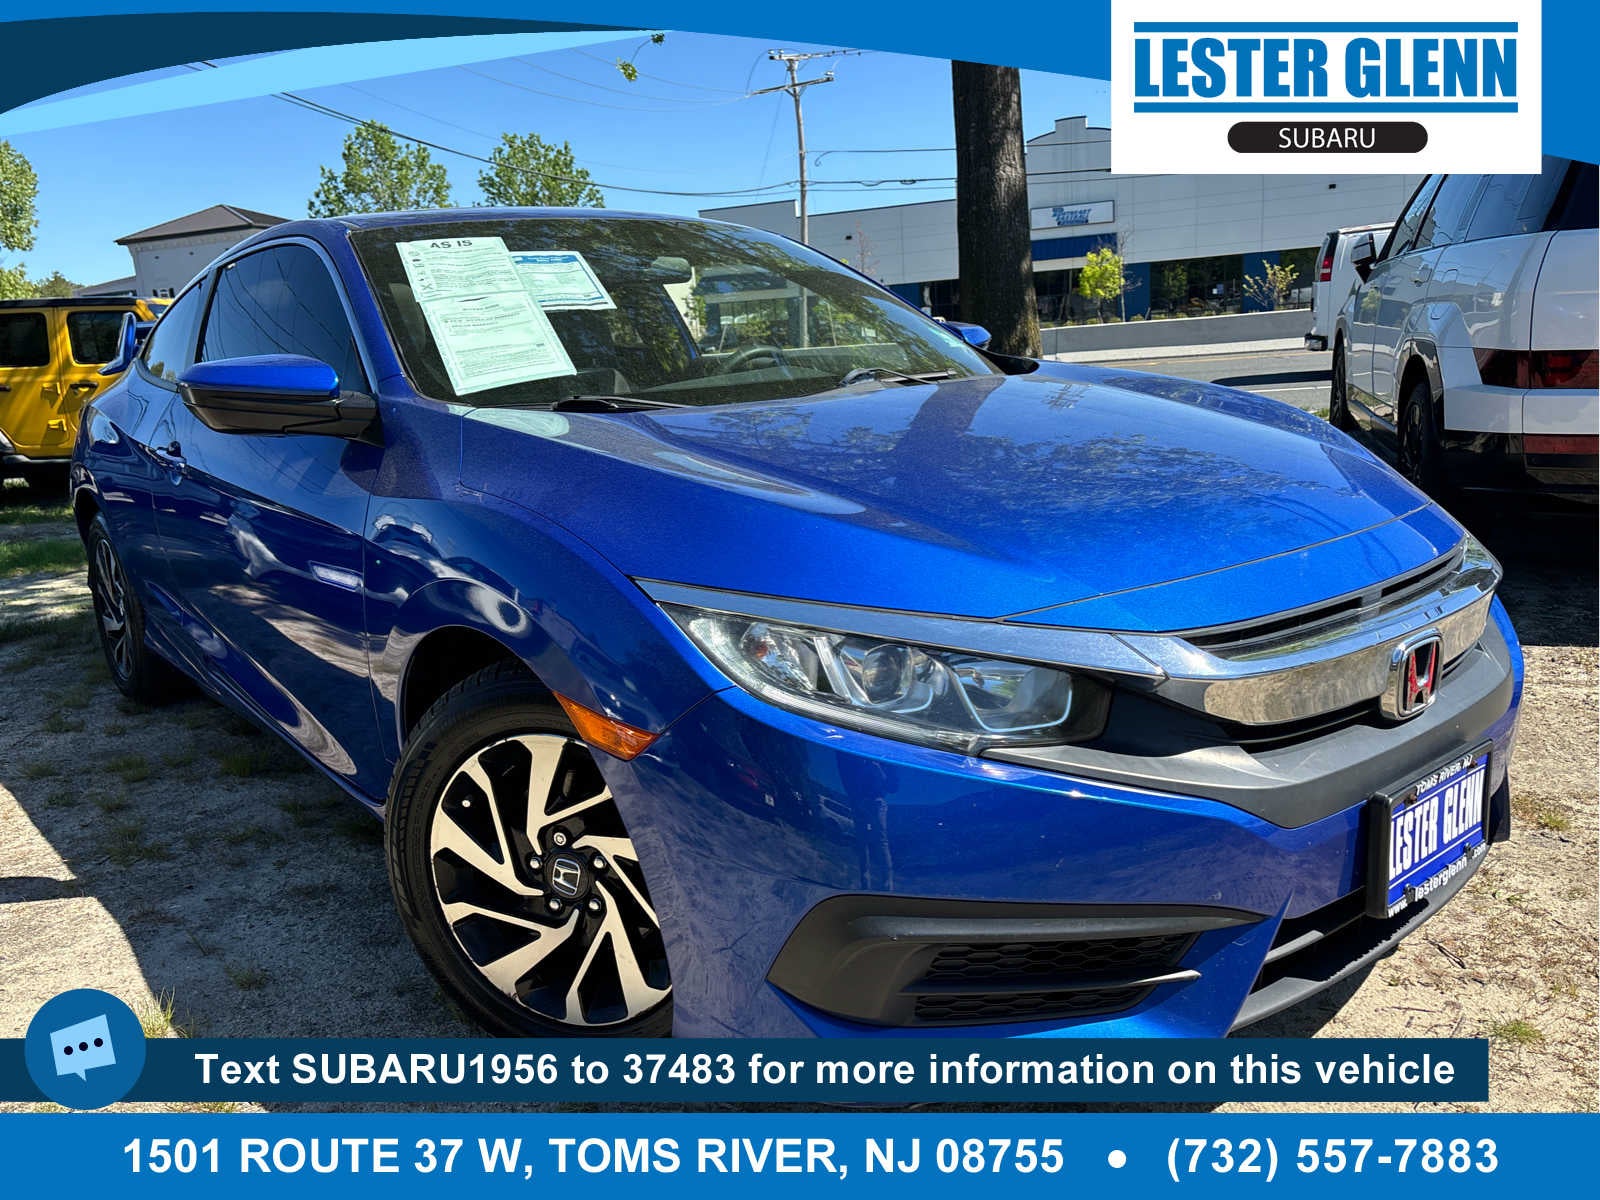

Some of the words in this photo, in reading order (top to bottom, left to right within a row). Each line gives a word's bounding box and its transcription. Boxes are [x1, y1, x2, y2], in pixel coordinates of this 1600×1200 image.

[430, 241, 452, 249] AS
[456, 239, 473, 248] IS
[1415, 774, 1439, 796] TOMS
[1388, 796, 1440, 881] LESTER
[1442, 768, 1485, 845] GLENN
